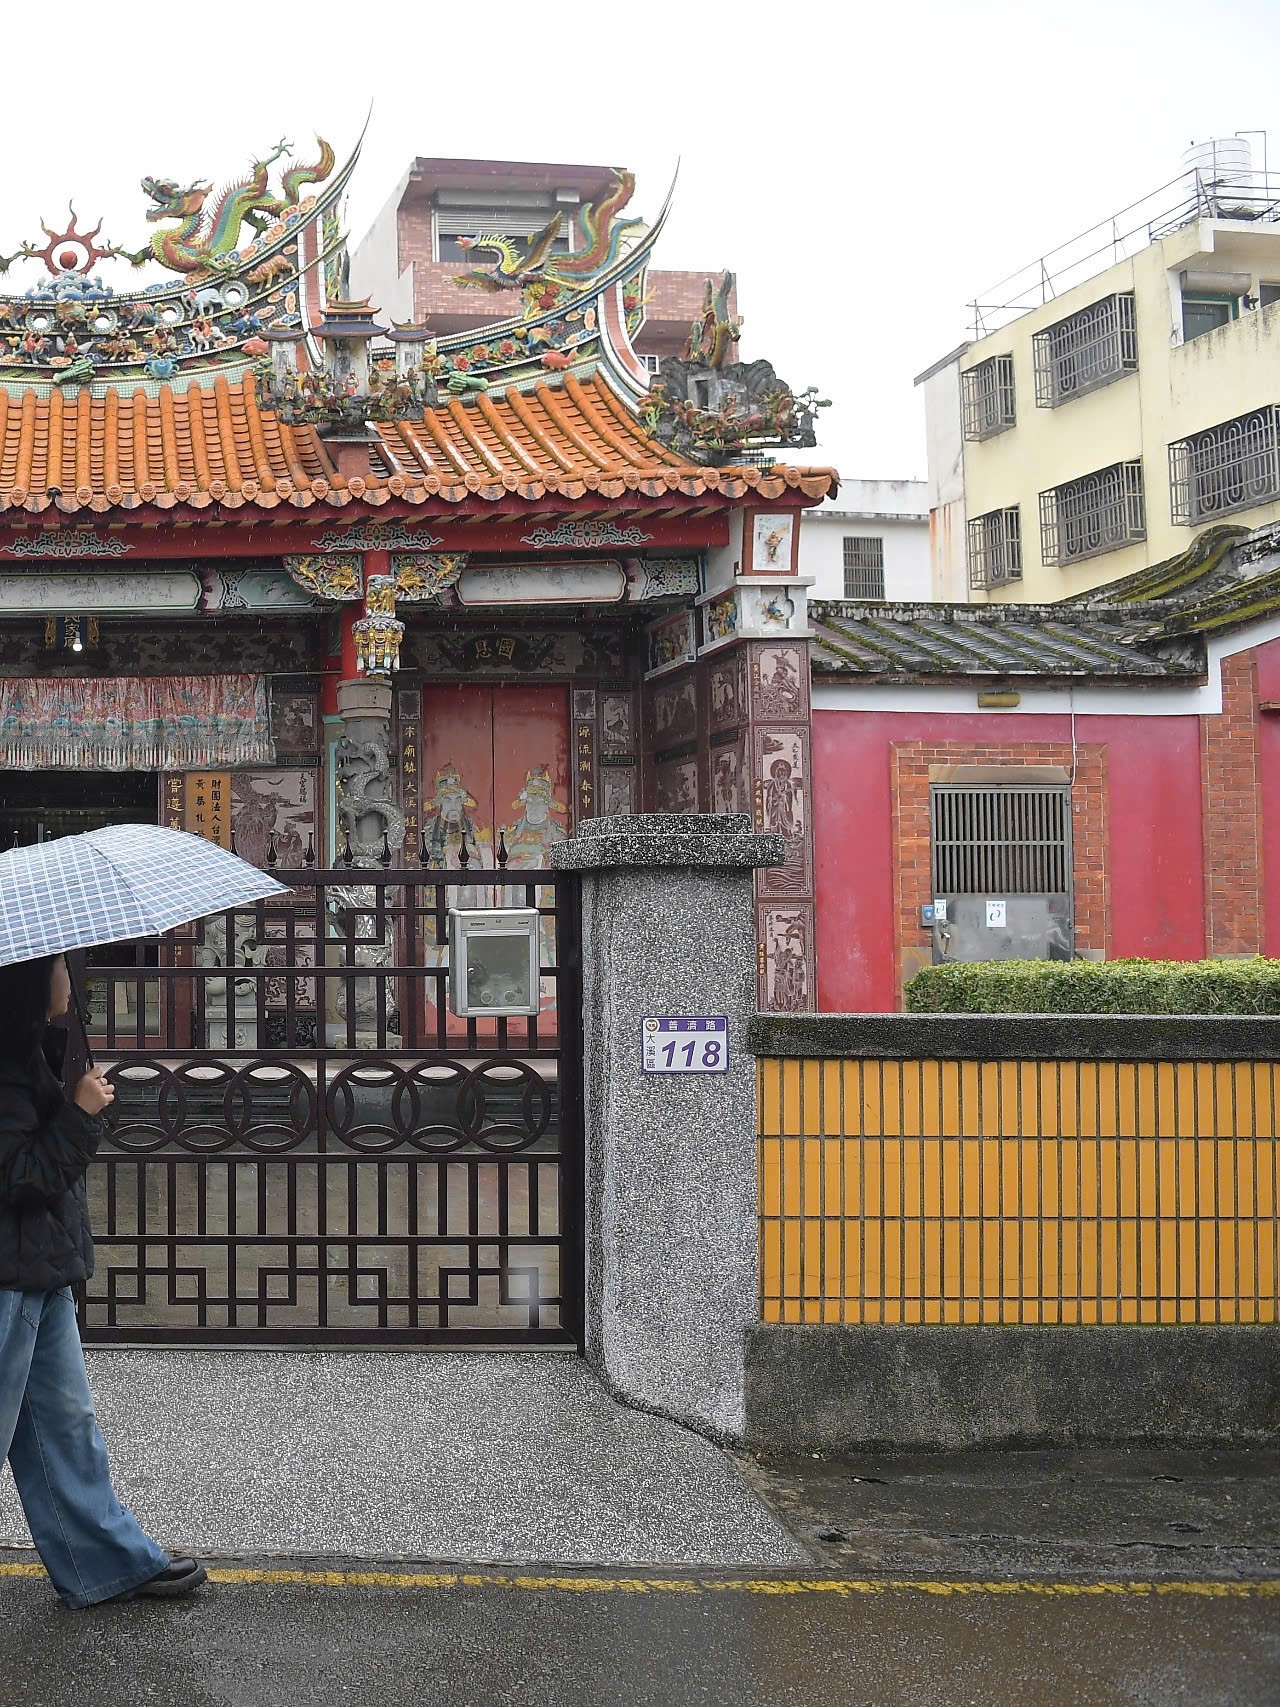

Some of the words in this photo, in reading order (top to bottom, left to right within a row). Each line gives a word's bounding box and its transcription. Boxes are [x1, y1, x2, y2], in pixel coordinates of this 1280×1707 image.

[668, 1020, 717, 1031] 普濟路
[645, 1033, 656, 1070] 大溪區
[661, 1040, 722, 1068] 118
